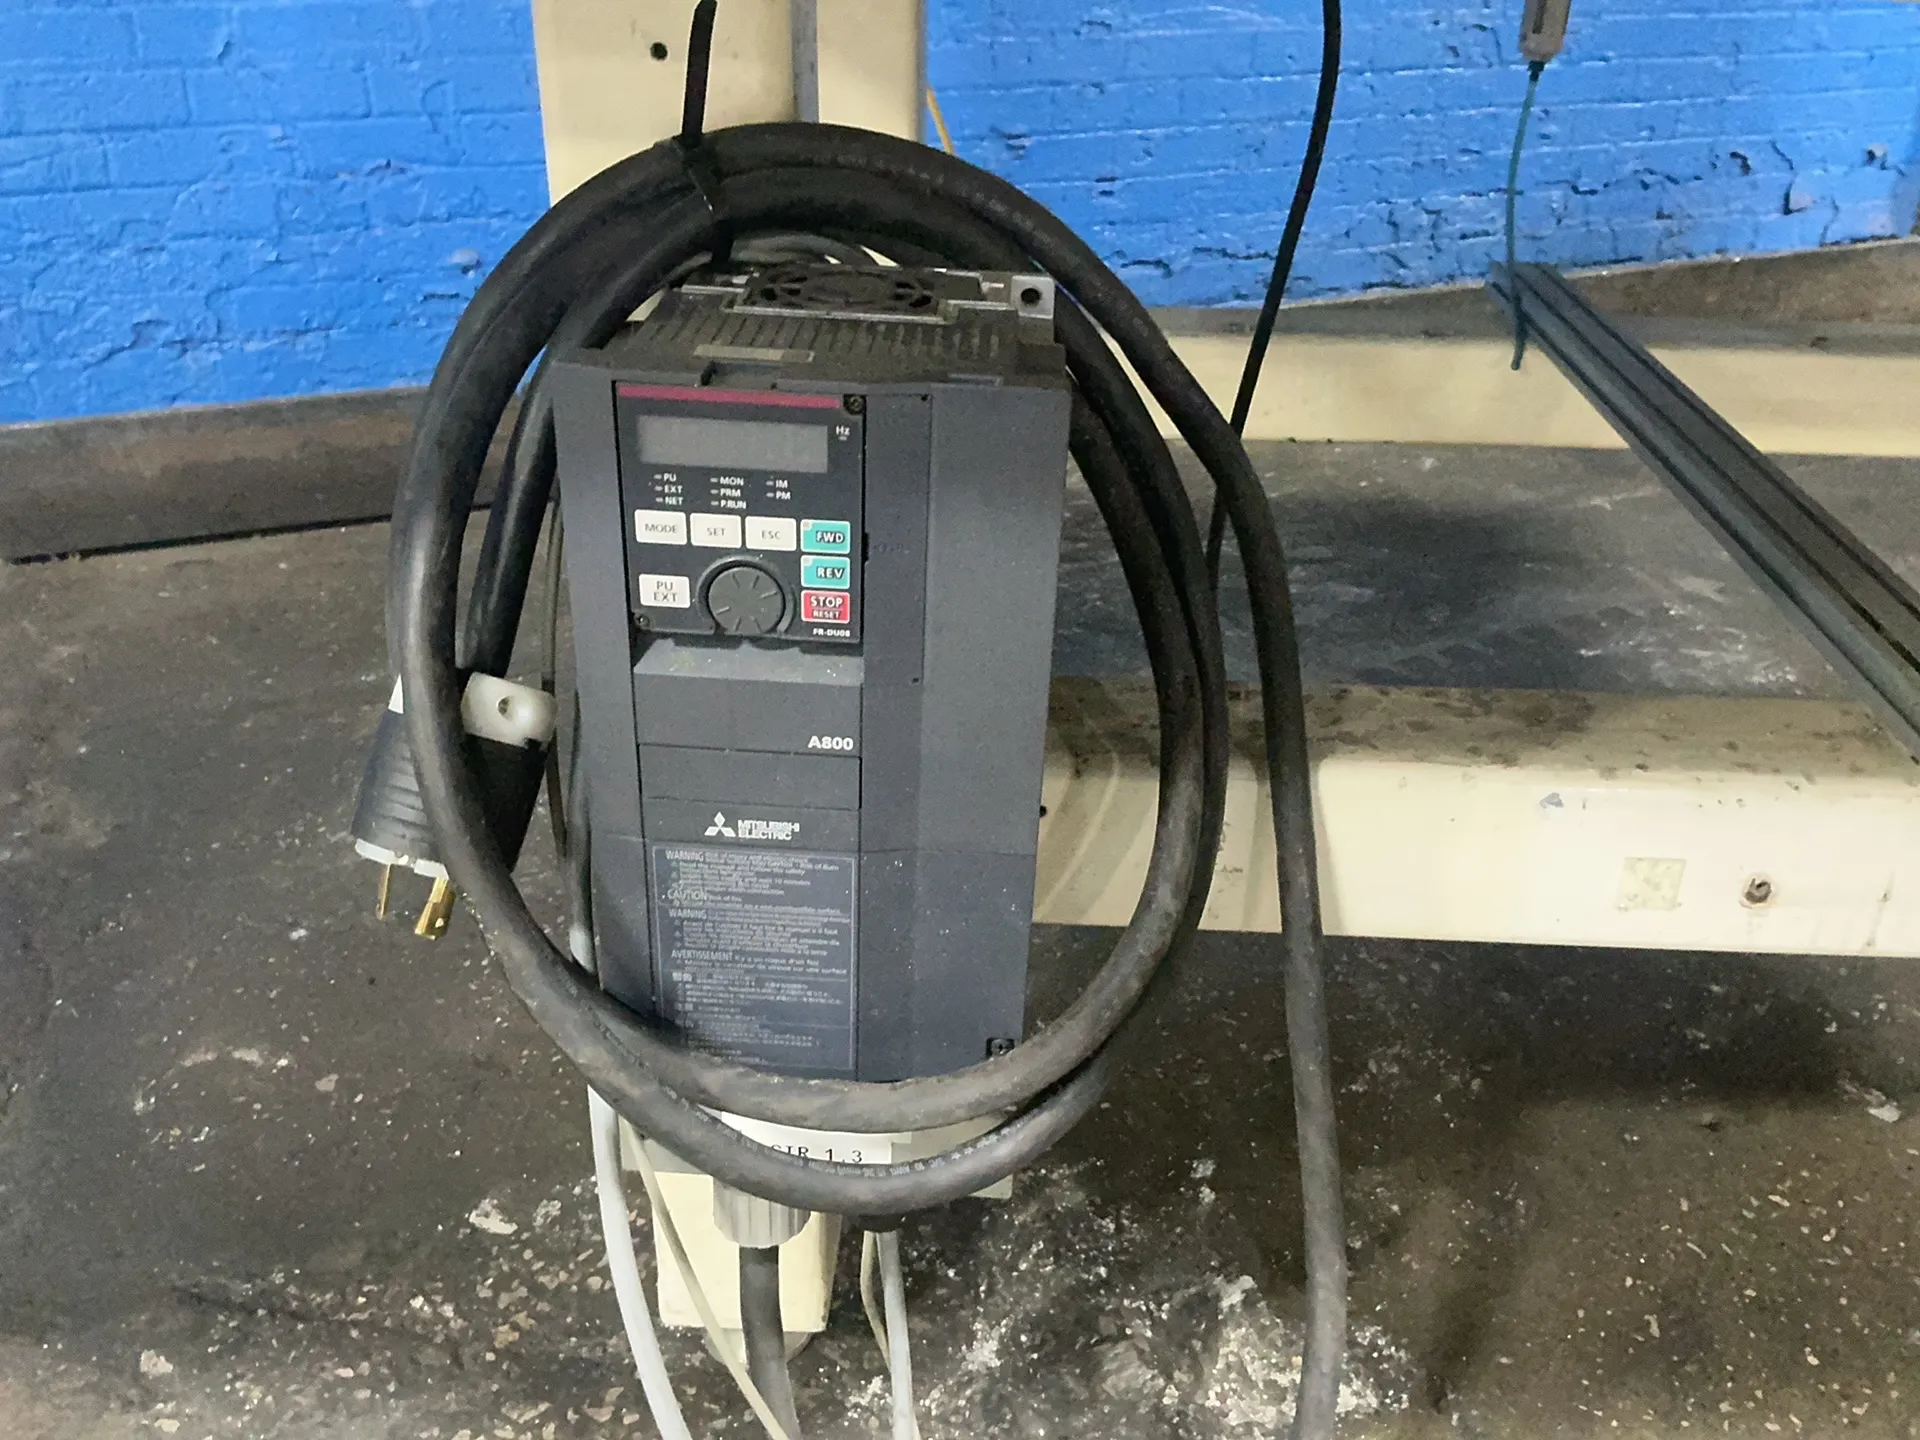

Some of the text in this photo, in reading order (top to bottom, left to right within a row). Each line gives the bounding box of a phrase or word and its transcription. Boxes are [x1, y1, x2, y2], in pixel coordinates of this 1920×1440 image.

[836, 426, 850, 435] Hz
[663, 473, 677, 482] PU
[720, 476, 744, 486] MON
[664, 485, 683, 494] EXT
[775, 480, 788, 489] IM
[720, 488, 742, 497] PRM
[775, 492, 791, 500] PM
[665, 496, 684, 505] NET
[644, 522, 678, 534] MODE
[706, 527, 726, 537] SET
[761, 530, 781, 540] ESC
[816, 531, 846, 544] FWD
[816, 566, 845, 579] REV
[656, 581, 674, 591] PU
[653, 592, 678, 603] EXT
[810, 595, 843, 608] STOP
[813, 609, 841, 619] RESET
[807, 735, 854, 750] A800
[738, 829, 793, 840] ELECTRIC
[665, 849, 705, 861] WARNING
[667, 888, 708, 901] CAUTION
[668, 908, 708, 920] WARNING
